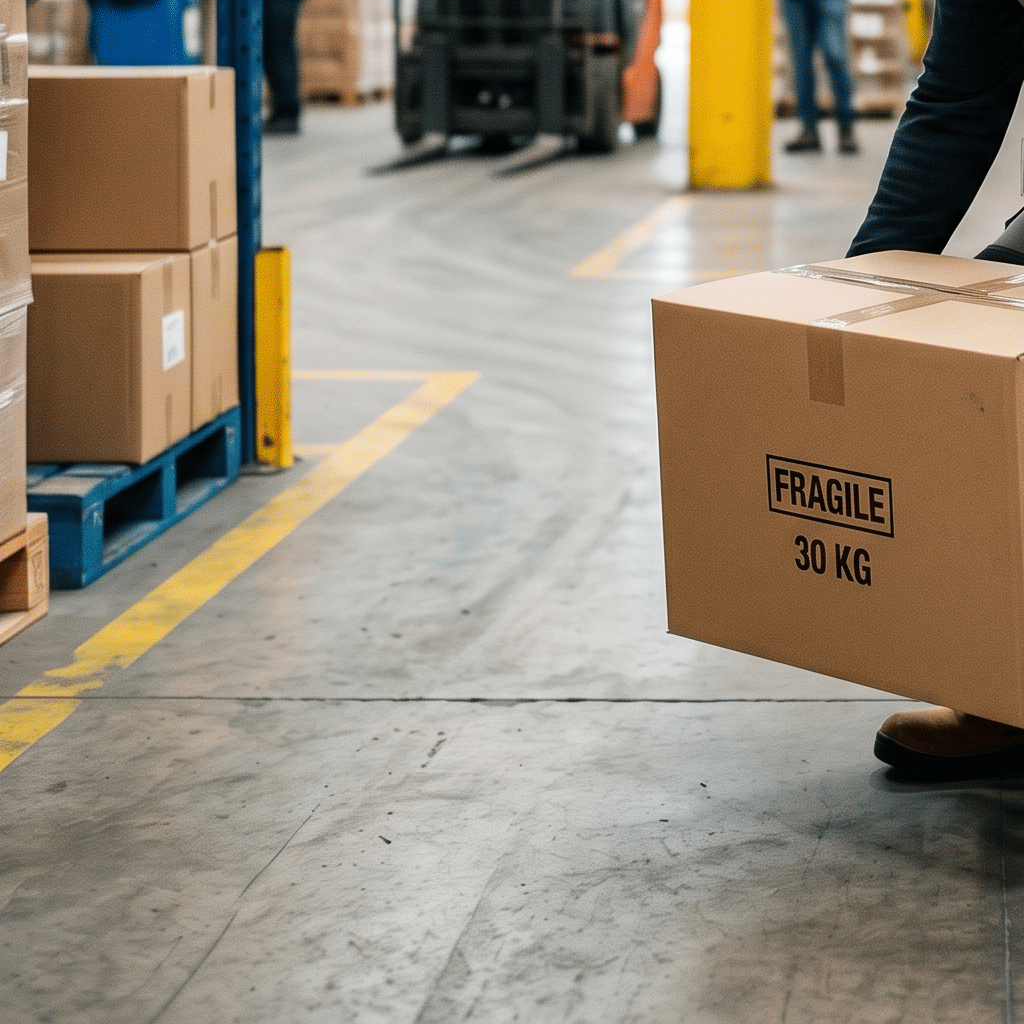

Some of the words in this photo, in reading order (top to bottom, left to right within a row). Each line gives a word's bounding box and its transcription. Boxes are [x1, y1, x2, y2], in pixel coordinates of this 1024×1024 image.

[774, 467, 886, 525] FRAGILE
[794, 534, 827, 575] 30
[834, 542, 872, 587] KG
